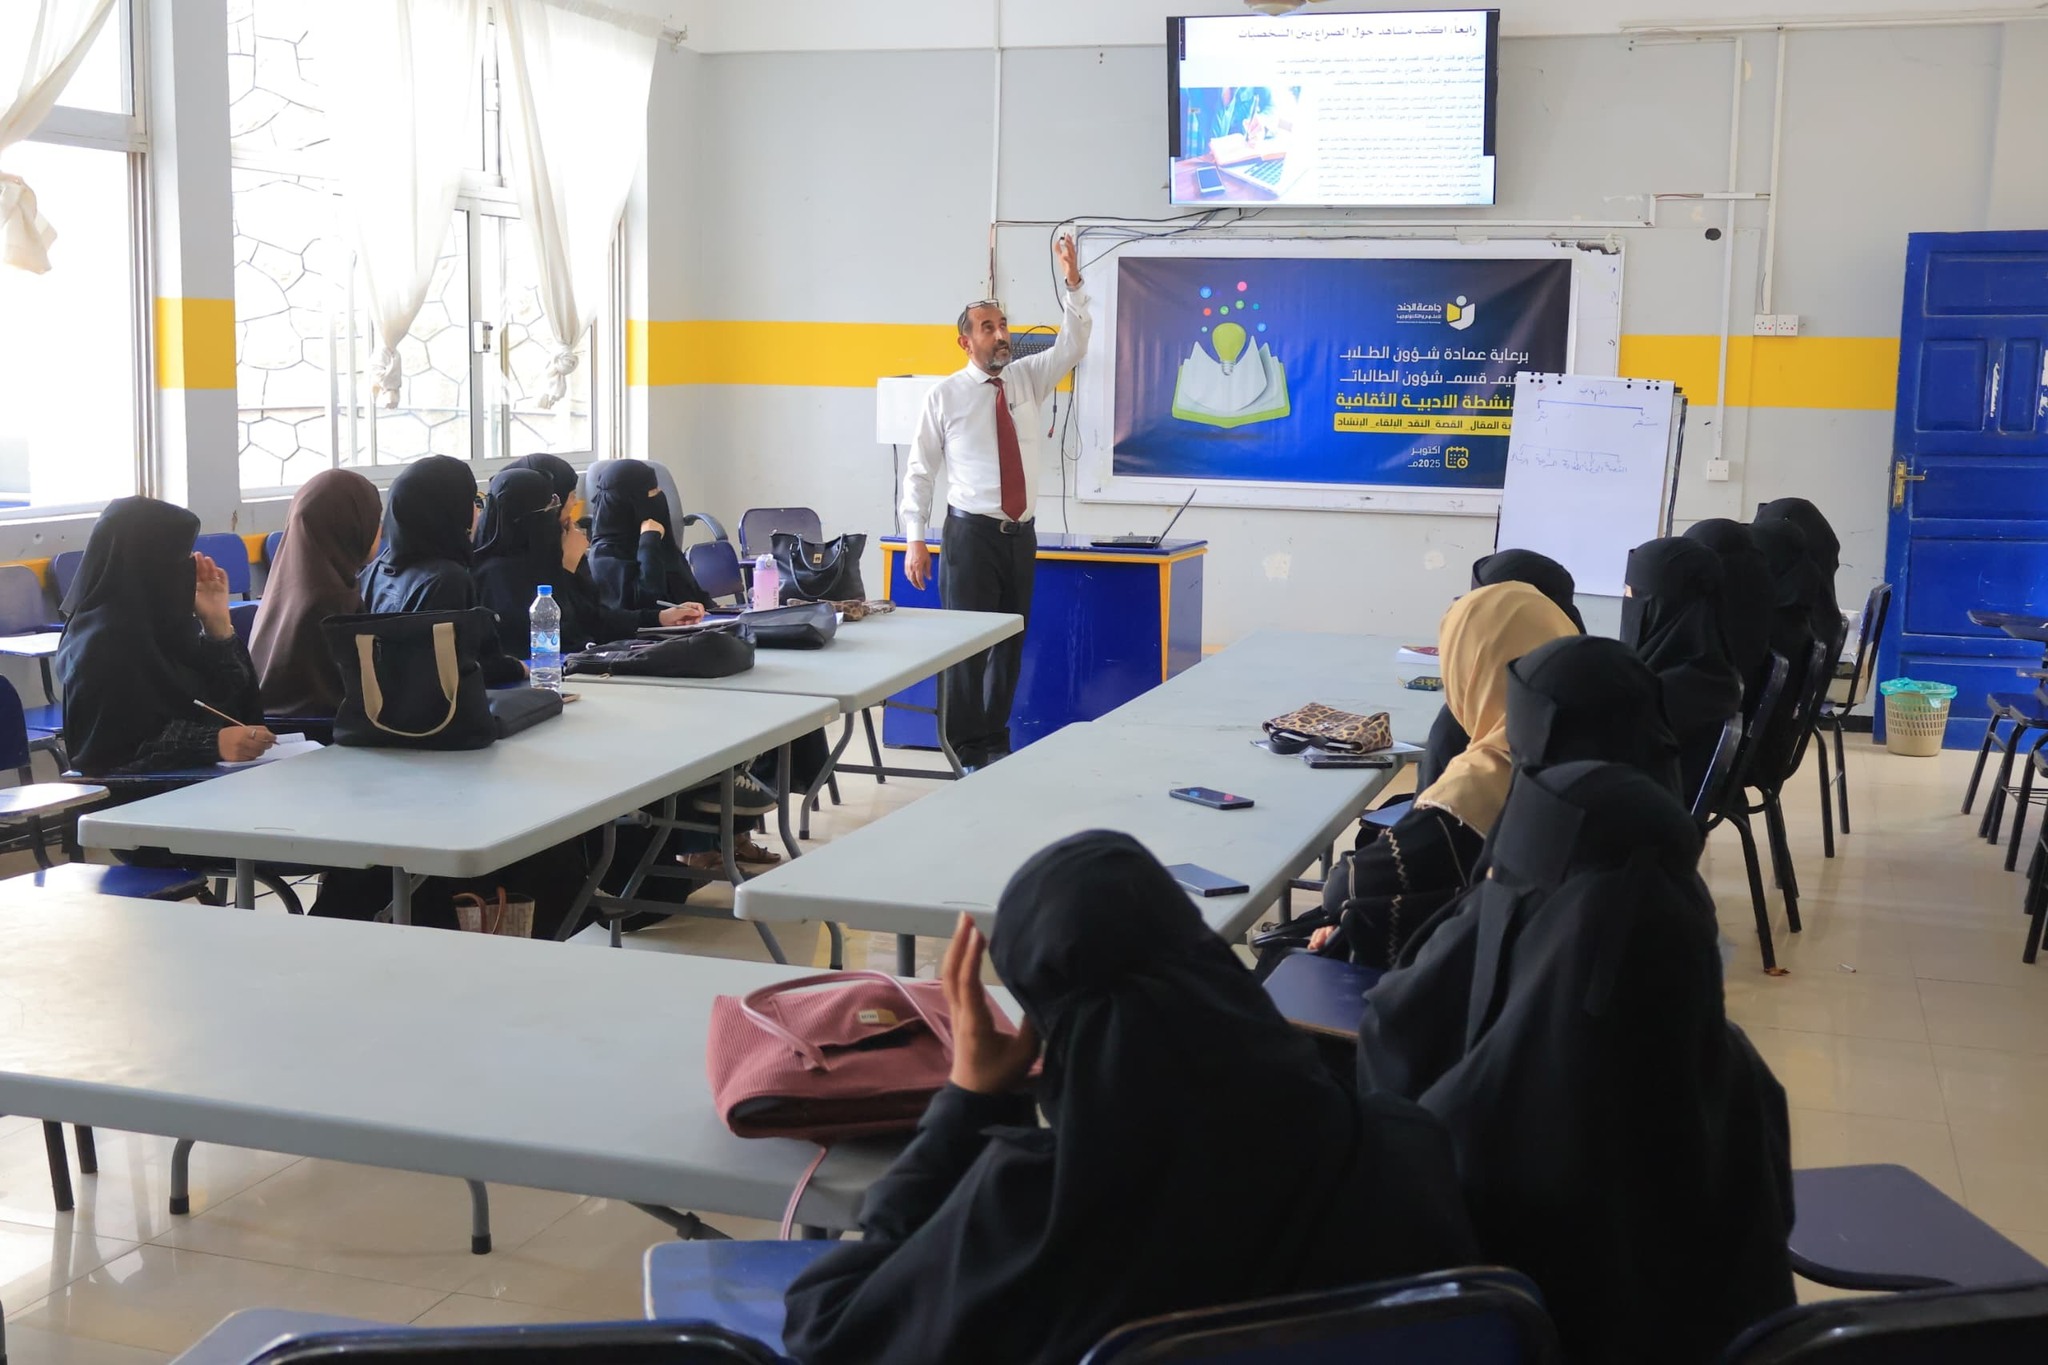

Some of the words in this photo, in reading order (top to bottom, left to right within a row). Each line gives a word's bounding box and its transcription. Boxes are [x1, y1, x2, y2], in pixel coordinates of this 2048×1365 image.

[1239, 27, 1294, 40] الشخصيات
[1296, 29, 1313, 40] بين
[1315, 27, 1349, 42] الصراع
[1352, 27, 1374, 39] حول
[1396, 302, 1416, 313] الجند
[1416, 302, 1442, 314] جامعة
[1393, 345, 1440, 363] شؤون
[1444, 347, 1486, 361] عمادة
[1490, 348, 1529, 364] برعاية
[1402, 370, 1443, 387] شؤون
[1336, 391, 1397, 410] الثقافية
[1402, 393, 1458, 411] الأدبية
